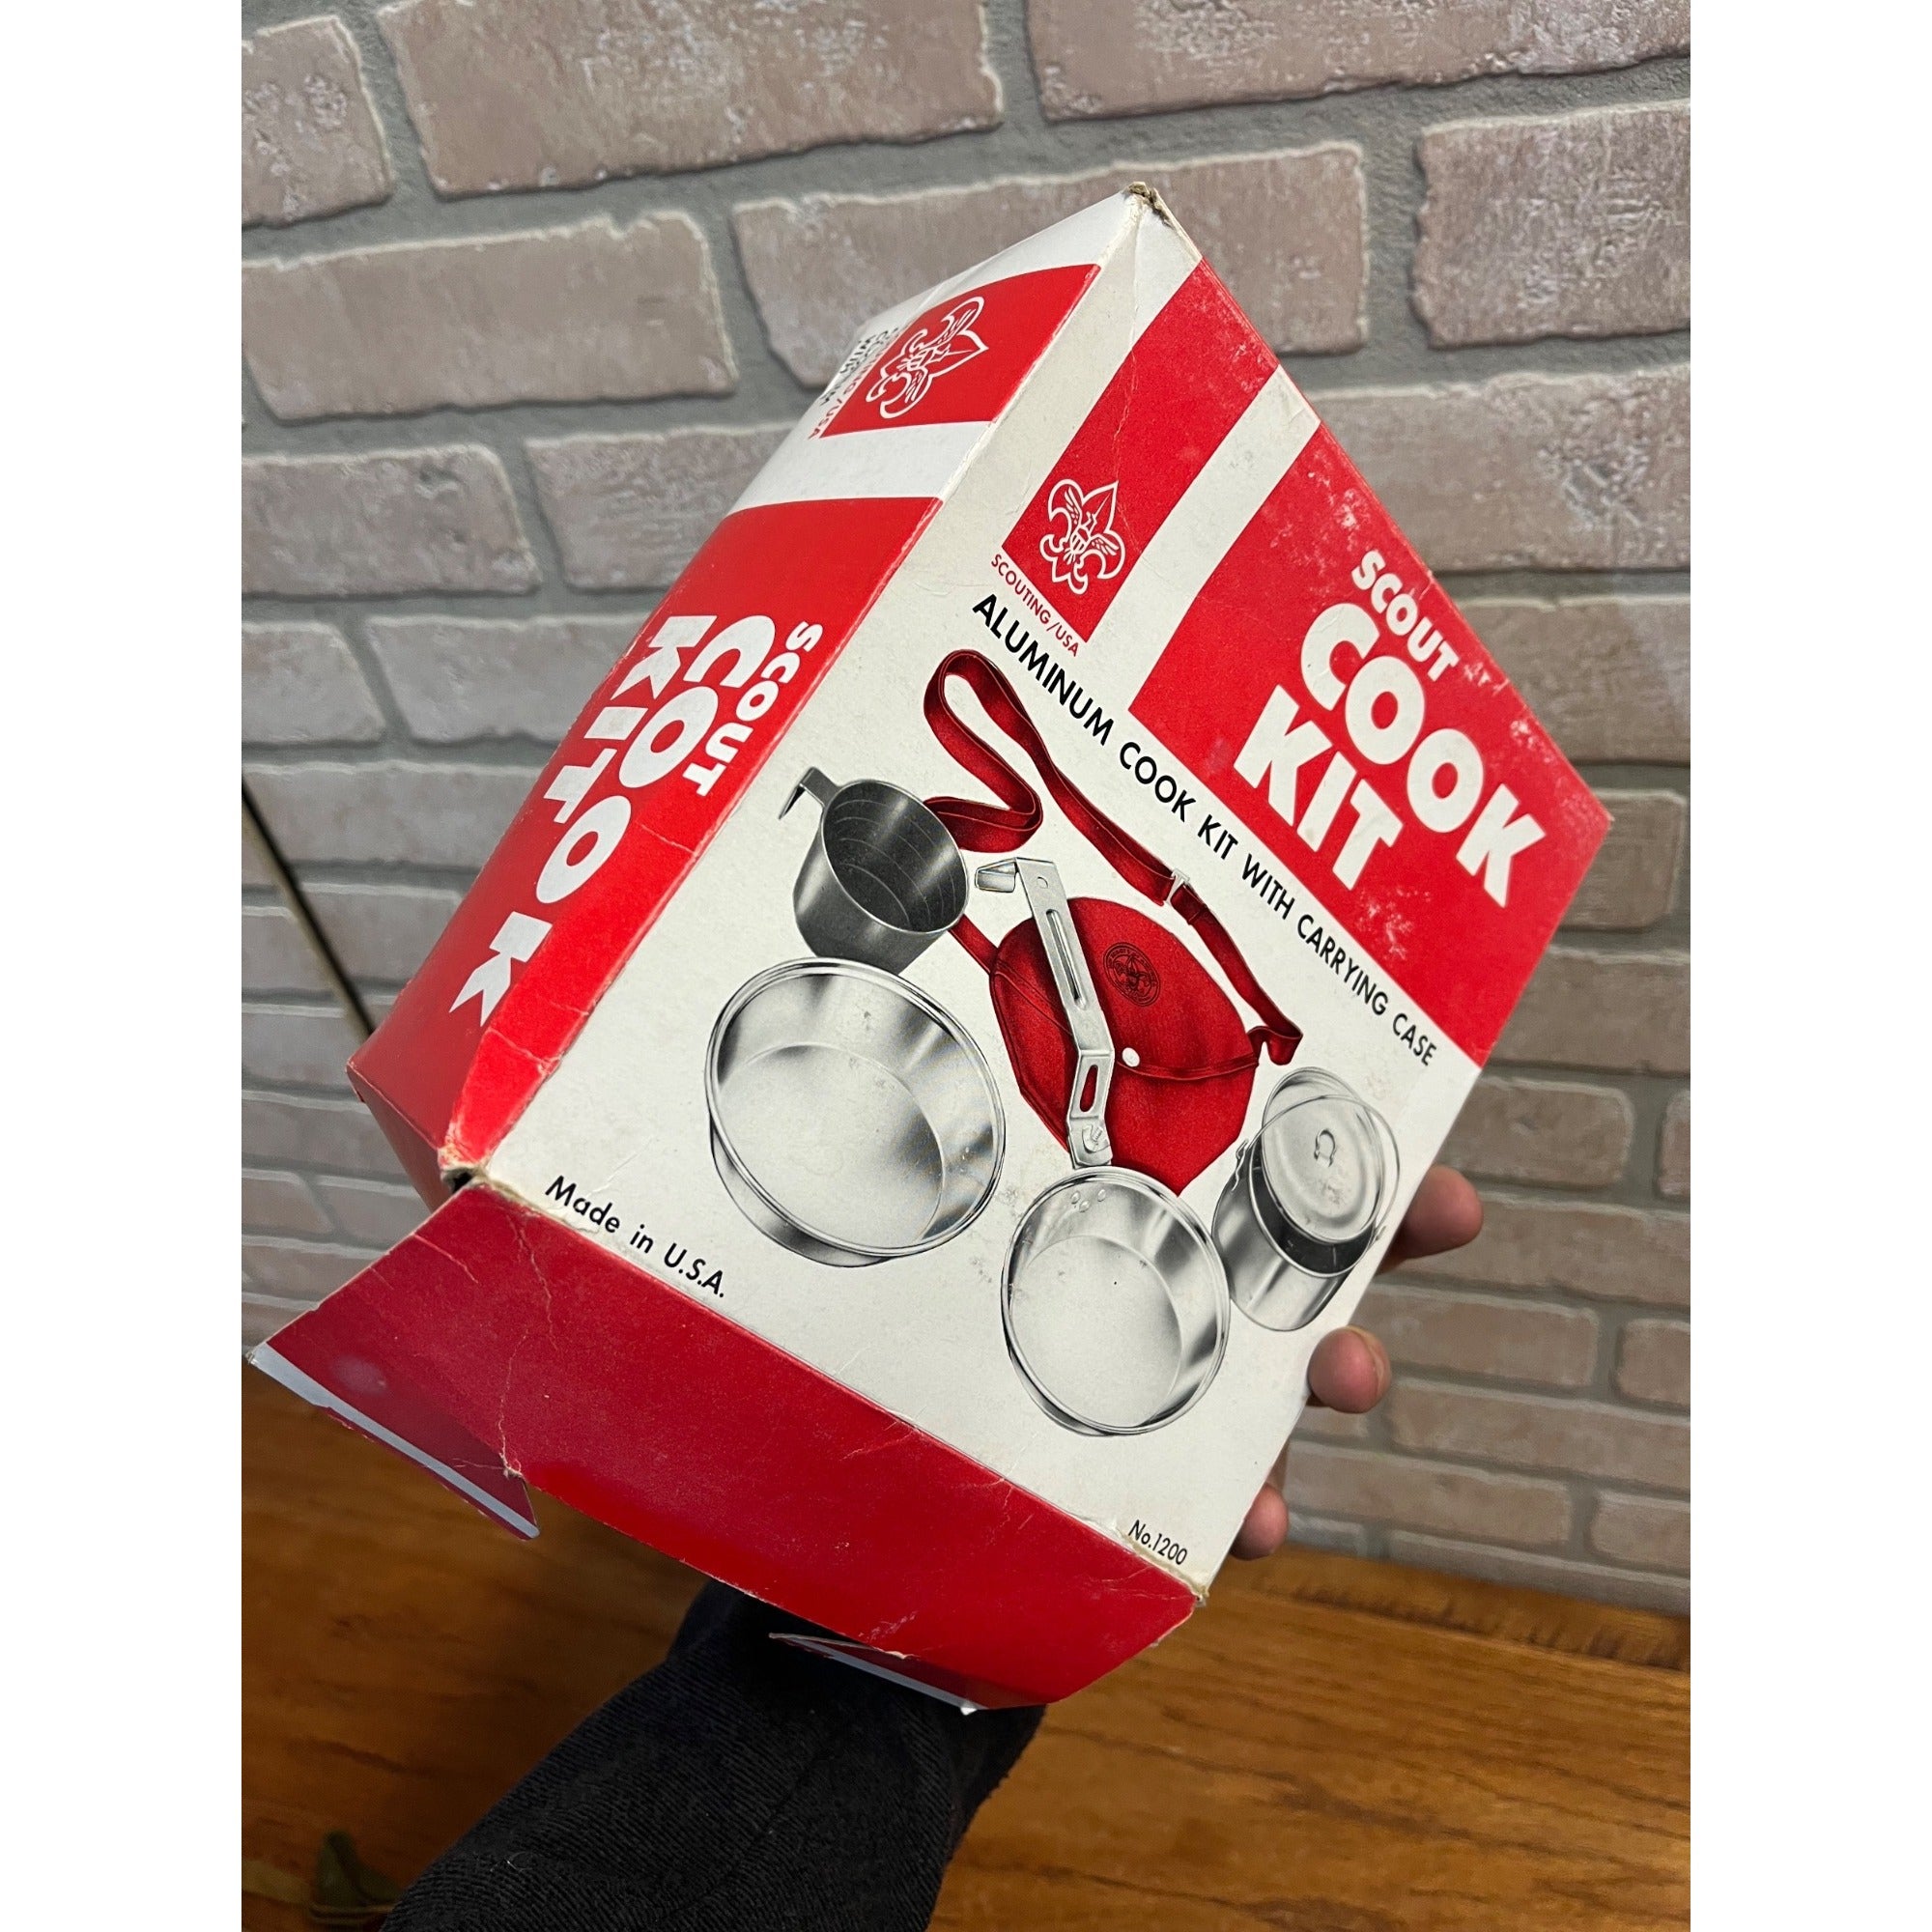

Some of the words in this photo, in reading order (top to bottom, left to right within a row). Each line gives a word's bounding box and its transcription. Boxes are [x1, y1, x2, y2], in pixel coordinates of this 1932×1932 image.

[991, 554, 1080, 657] SCOUTING/USA
[1351, 550, 1460, 682] SCOUT
[543, 615, 717, 824] KIT
[683, 621, 823, 797] SCOUT
[1234, 684, 1404, 891] KIT
[1300, 603, 1546, 908] COOK
[449, 615, 776, 1027] COOK
[972, 594, 1114, 746] ALUMINUM
[1120, 741, 1196, 822] COOK
[1197, 814, 1238, 860] KIT
[1241, 854, 1295, 920] WITH
[1297, 914, 1388, 1015] CARRYING
[1392, 1013, 1436, 1065] CASE
[545, 1175, 620, 1233] Made
[630, 1224, 654, 1254] in
[664, 1242, 724, 1298] U.S.A.
[1128, 1520, 1187, 1565] No.1200
